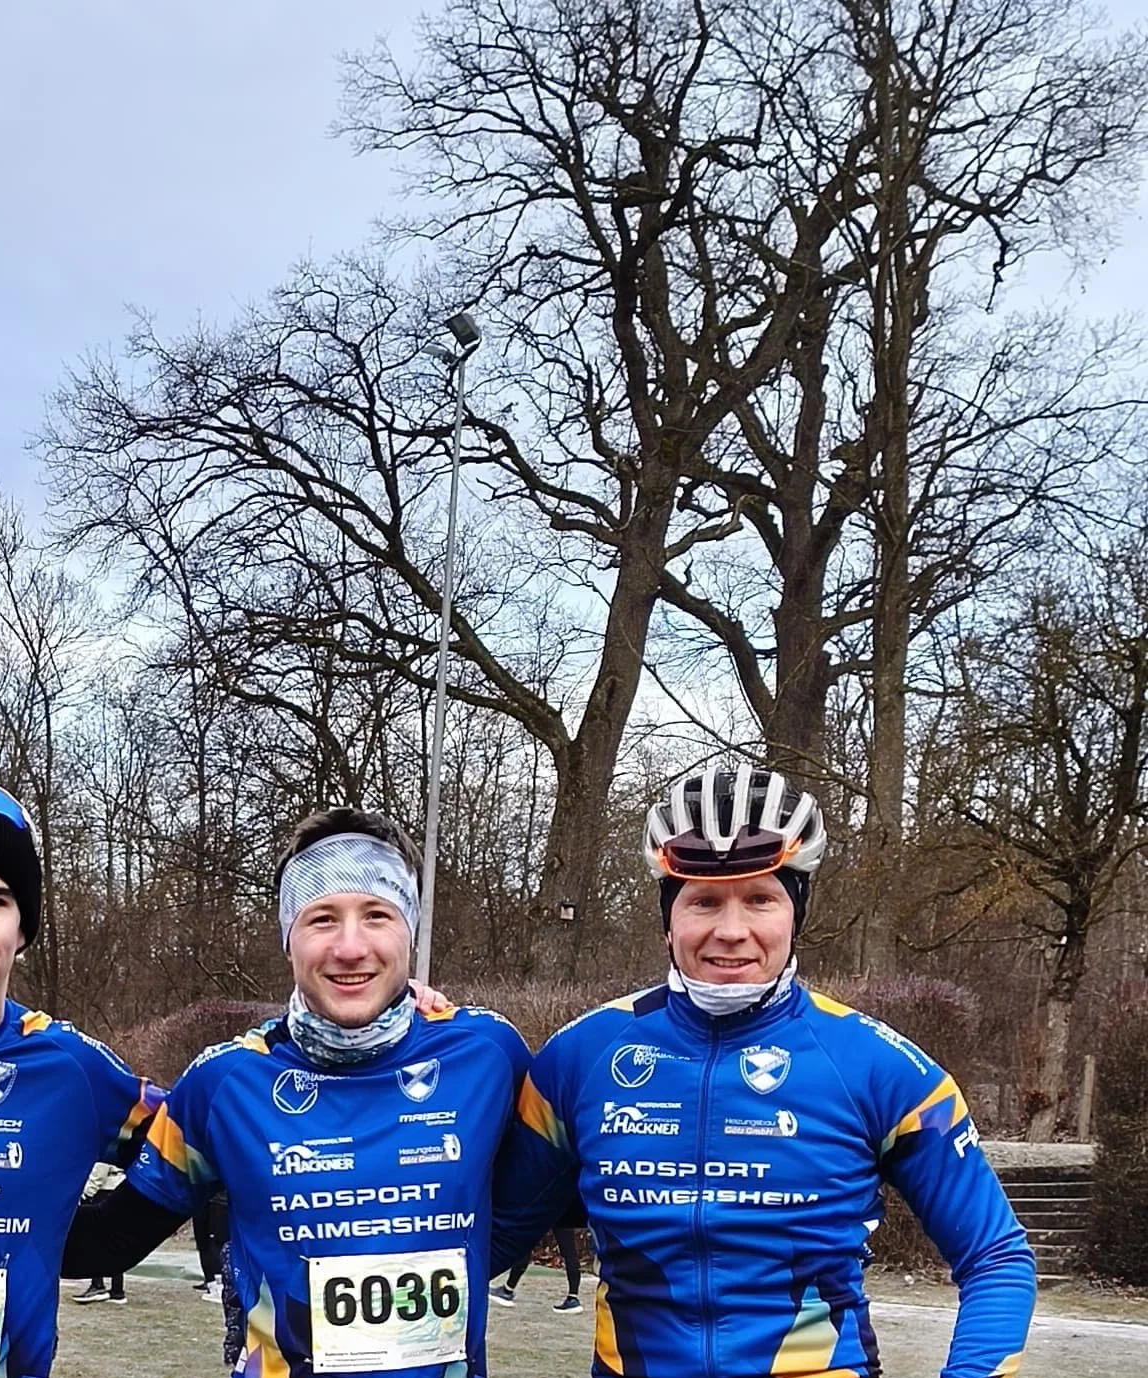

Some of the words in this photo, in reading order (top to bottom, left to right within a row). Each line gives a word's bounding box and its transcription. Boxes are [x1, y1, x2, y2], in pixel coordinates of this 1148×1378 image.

[599, 1160, 771, 1178] RADSPORT
[270, 1183, 441, 1212] RADSPORT
[278, 1212, 475, 1242] GAIMERSHEIM
[323, 1268, 460, 1326] 6036
